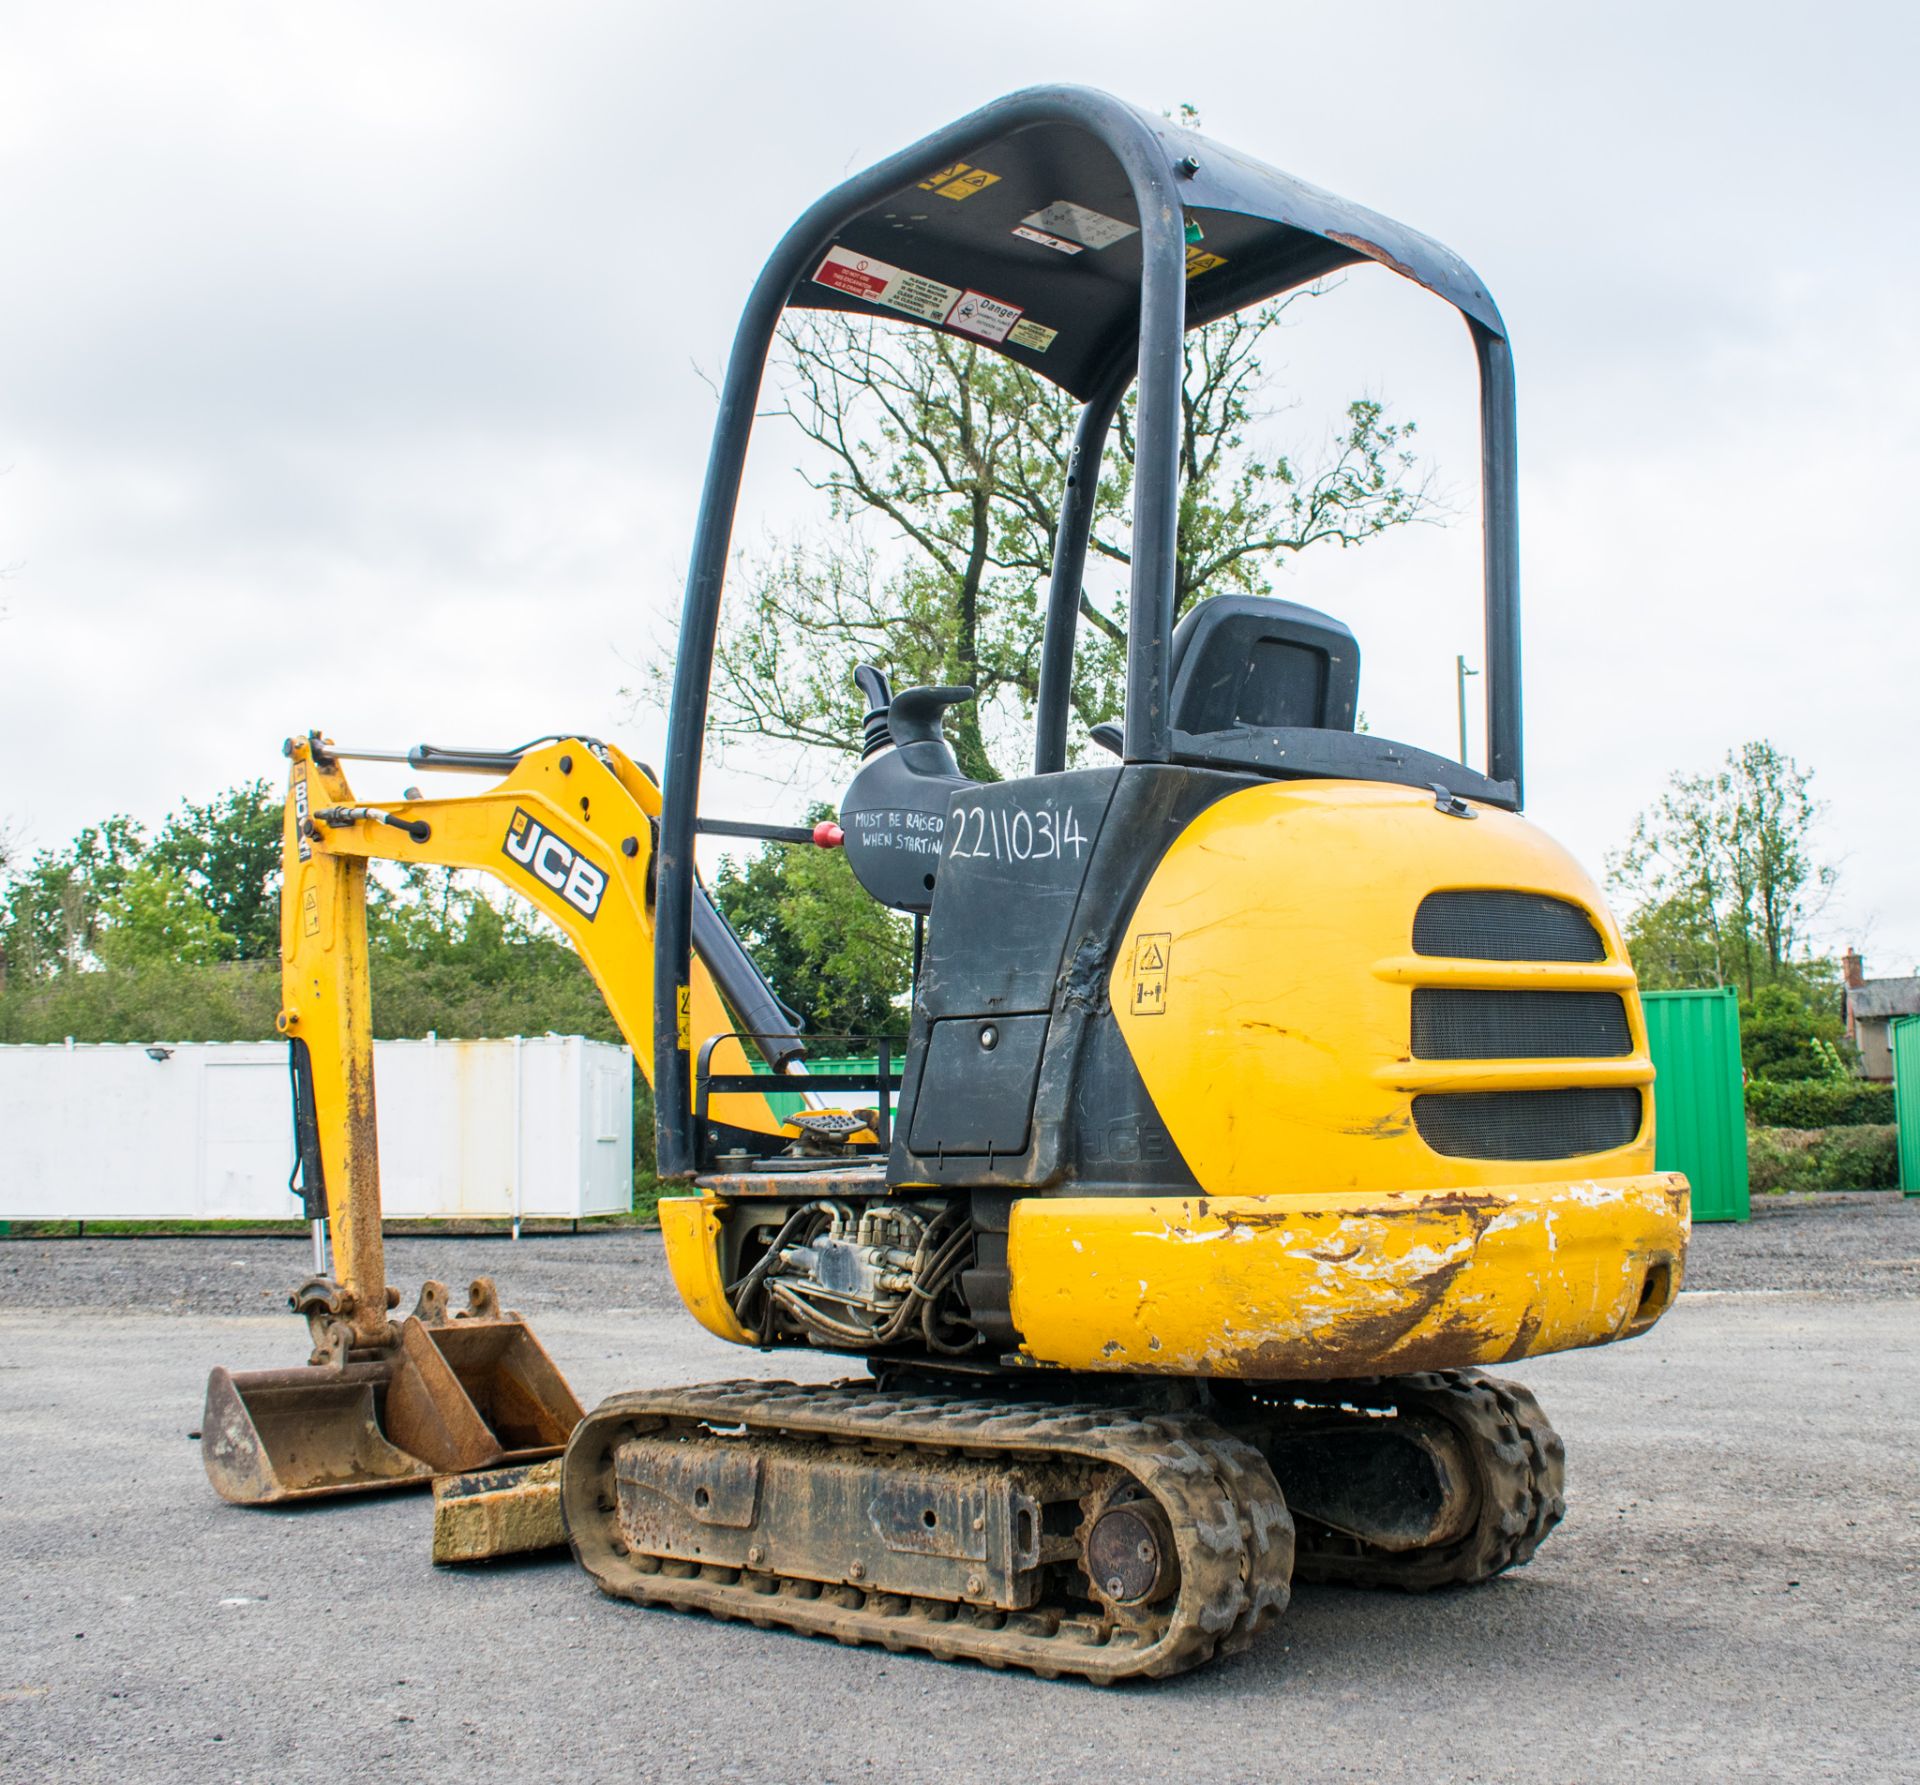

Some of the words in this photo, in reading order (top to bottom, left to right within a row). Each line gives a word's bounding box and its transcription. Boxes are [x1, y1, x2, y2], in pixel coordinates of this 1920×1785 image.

[980, 299, 1018, 319] Danger
[855, 813, 882, 828] MUST
[889, 813, 901, 828] BE
[950, 806, 1088, 863] 22110314
[862, 833, 892, 847] WHEN
[507, 824, 604, 914] JCB
[1082, 1127, 1170, 1163] JCB
